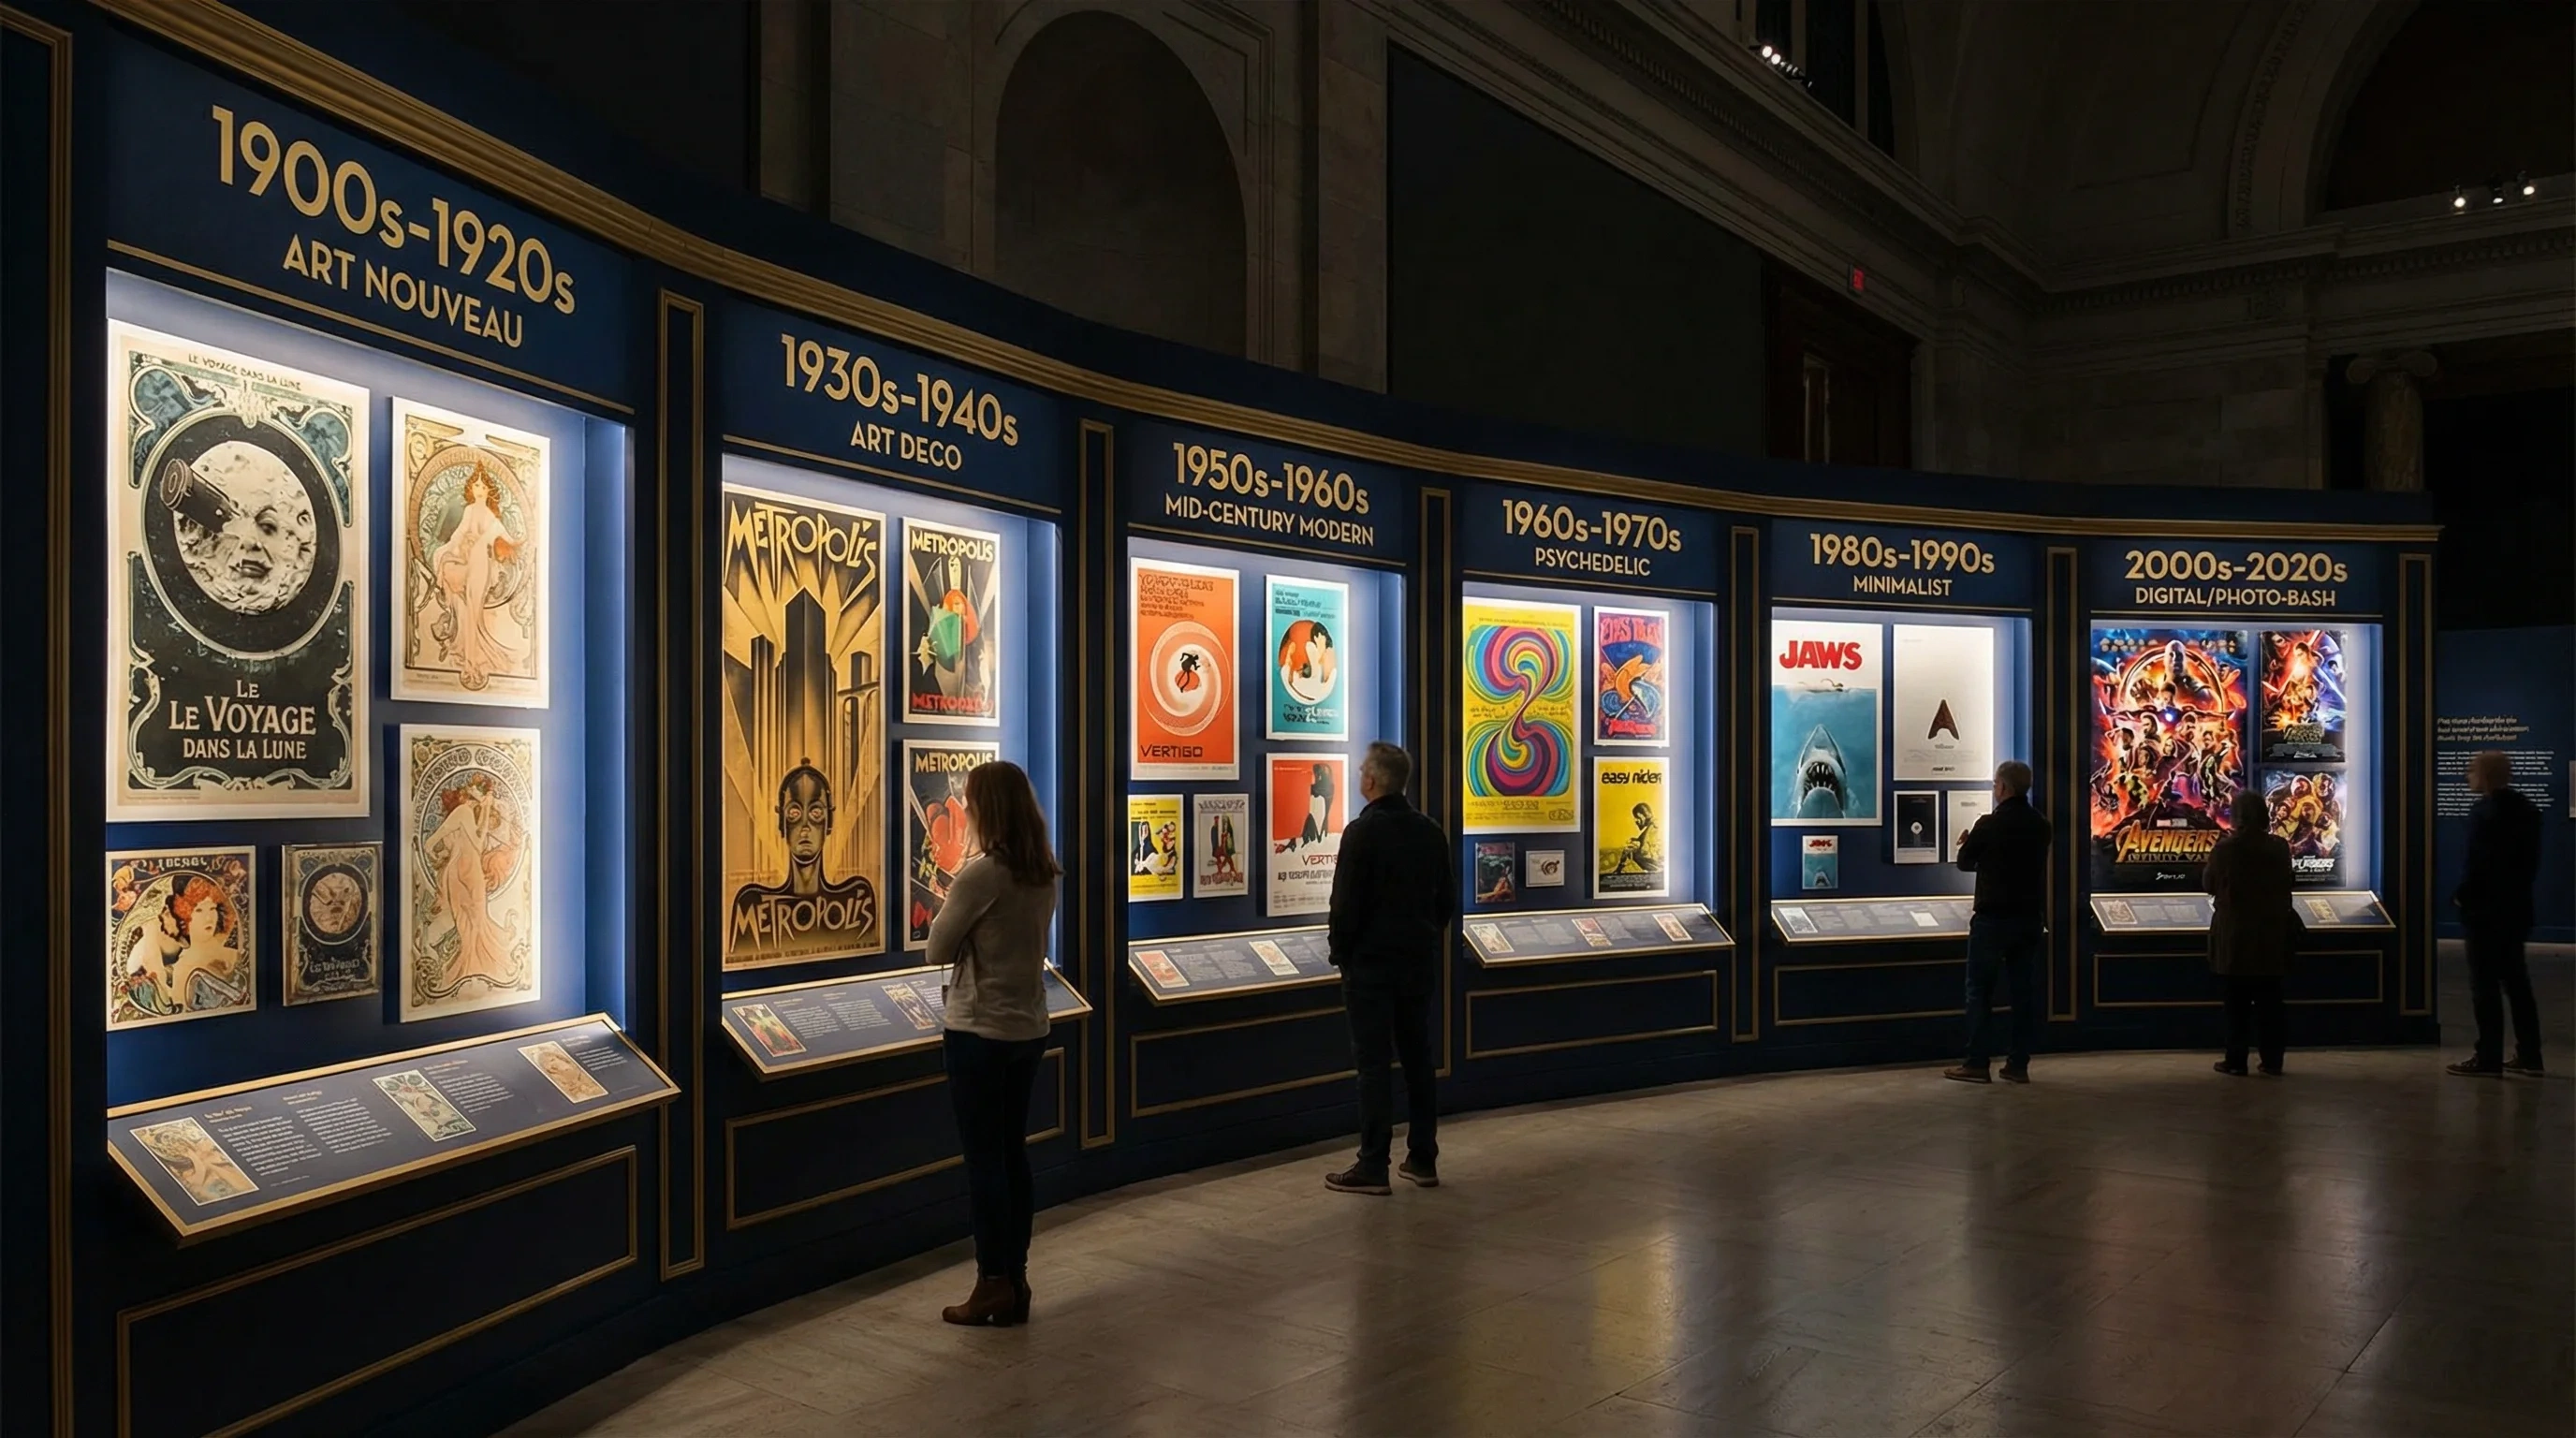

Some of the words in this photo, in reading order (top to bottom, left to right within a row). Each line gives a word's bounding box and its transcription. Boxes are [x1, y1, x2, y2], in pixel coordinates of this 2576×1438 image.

[212, 104, 576, 315] 1900s-1920s
[283, 233, 356, 291] ART
[365, 259, 523, 348] NOUVEAU
[188, 353, 198, 364] LE
[267, 374, 277, 384] LA
[781, 333, 1018, 447] 1930s-1940s
[850, 420, 895, 455] ART
[900, 432, 962, 471] DECO
[1173, 442, 1369, 515] 1950s-1960s
[1164, 492, 1295, 534] MID-CENTURY
[1299, 515, 1374, 547] MODERN
[1502, 499, 1682, 552] 1960s-1970s
[724, 500, 877, 613] METROPOLIS
[911, 530, 994, 563] METROPOLIS
[1535, 547, 1651, 577] PSYCHEDELIC
[1809, 533, 1995, 574] 1980s-1990s
[2124, 550, 2349, 582] 2000s-2020s
[1853, 575, 1953, 596] MINIMALIST
[2135, 586, 2336, 608] DIGITAL/PHOTO-BASH
[1779, 639, 1863, 671] JAWS
[236, 679, 260, 698] LE
[168, 700, 201, 731] LE
[204, 695, 316, 736] VOYAGE
[183, 738, 230, 759] DANS
[236, 739, 257, 759] LA
[262, 738, 307, 760] LUNE
[1140, 743, 1203, 758] VERTIGO
[1602, 771, 1631, 785] easy
[2115, 819, 2220, 863] AVENGERS
[730, 889, 875, 953] METROPOLIS
